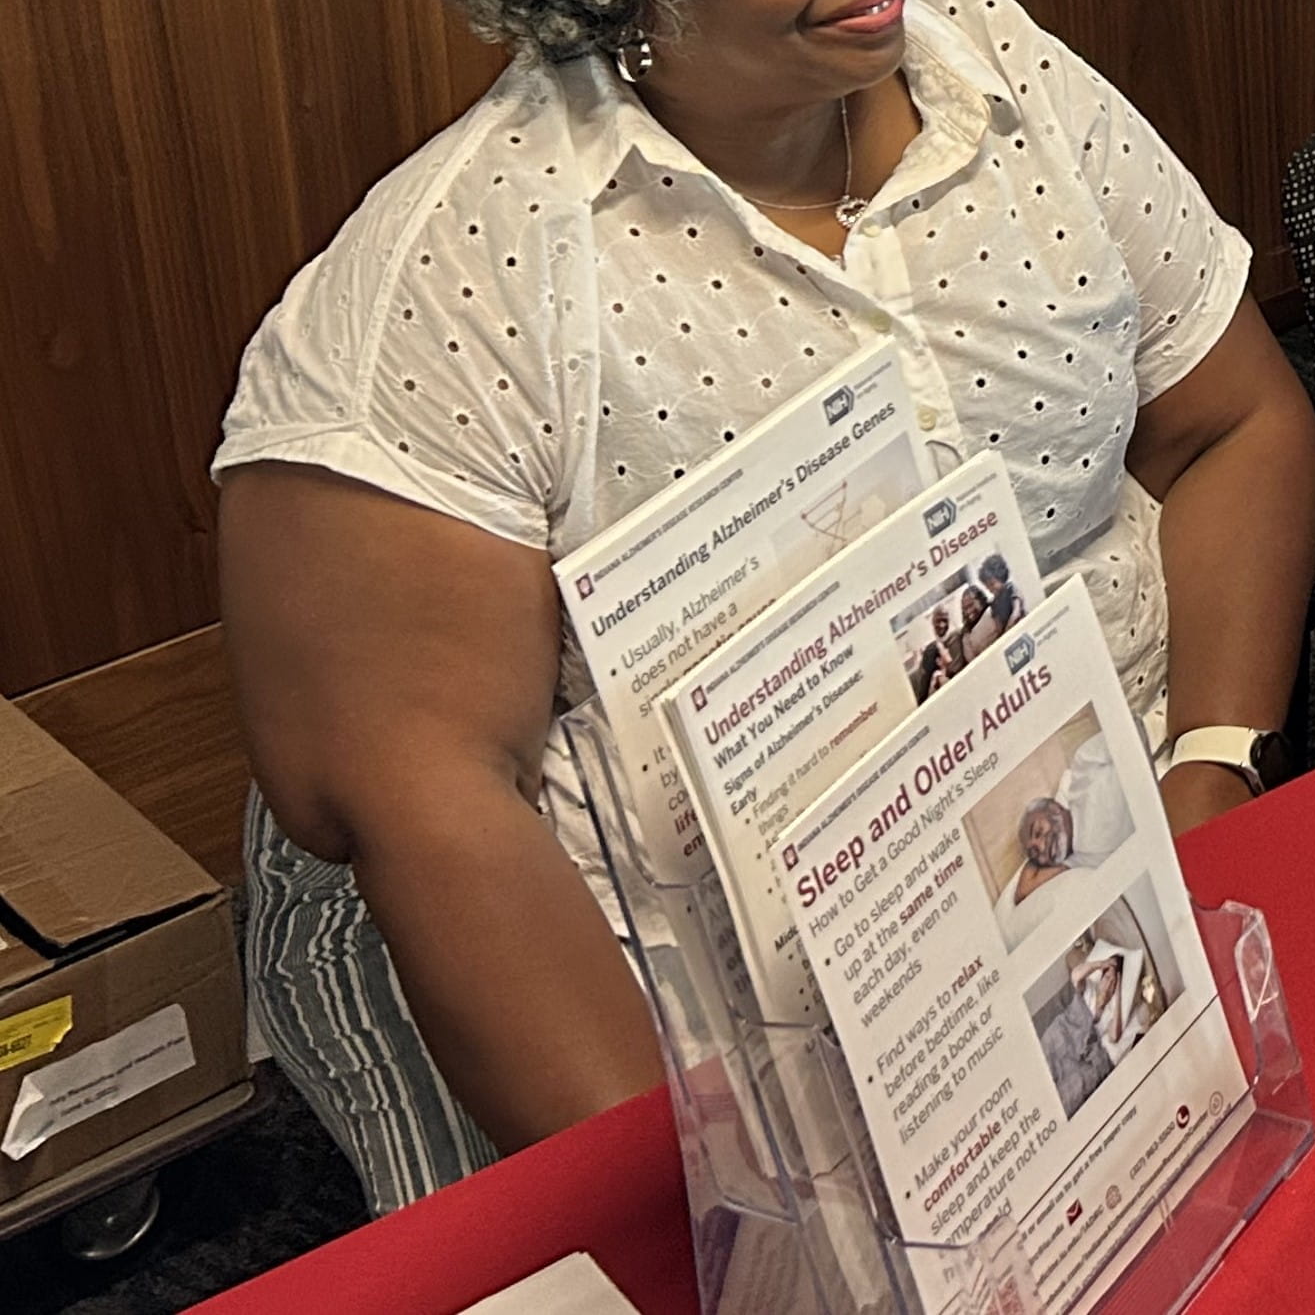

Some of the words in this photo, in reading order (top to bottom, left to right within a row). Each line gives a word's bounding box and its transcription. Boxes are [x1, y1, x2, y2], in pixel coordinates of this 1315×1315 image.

[590, 542, 711, 637] Understanding
[712, 477, 795, 550] Alzheimer's
[794, 435, 851, 484] Disease
[851, 402, 896, 440] Genes
[630, 658, 667, 694] does
[667, 635, 694, 666] not
[691, 610, 727, 645] have
[703, 635, 827, 746] Understanding
[828, 559, 928, 645] Alzheimer's
[928, 511, 998, 567] Disease
[712, 733, 749, 769] What
[747, 713, 774, 740] You
[772, 682, 806, 719] Need
[819, 644, 853, 679] Know
[796, 835, 865, 908] Sleep
[868, 782, 913, 843] and
[913, 728, 974, 796] Older
[981, 664, 1052, 740] Adults
[808, 902, 839, 938] How
[853, 862, 879, 893] Get
[886, 819, 921, 861] Good
[962, 751, 999, 788] Sleep
[833, 932, 855, 957] Go
[869, 882, 904, 923] sleep
[903, 854, 929, 889] and
[927, 827, 961, 863] wake
[875, 920, 899, 948] the
[898, 884, 934, 926] same
[933, 854, 964, 889] time
[860, 958, 922, 1028] weekends
[875, 1035, 906, 1076] Find
[904, 1004, 937, 1044] ways
[950, 955, 984, 995] relax
[883, 1048, 926, 1099] before
[976, 968, 1000, 997] like
[892, 1063, 941, 1122] reading
[947, 1020, 980, 1060] book
[898, 1080, 954, 1145] listening
[966, 1025, 1003, 1072] music
[913, 1146, 950, 1190] Make
[949, 1112, 978, 1156] your
[978, 1076, 1013, 1119] room
[923, 1120, 1002, 1212] comfortable
[1000, 1097, 1019, 1125] for
[930, 1192, 966, 1236] sleep
[965, 1159, 990, 1197] and
[988, 1130, 1020, 1169] keep
[1018, 1106, 1041, 1135] the
[1014, 1139, 1037, 1172] not
[1035, 1118, 1057, 1147] too
